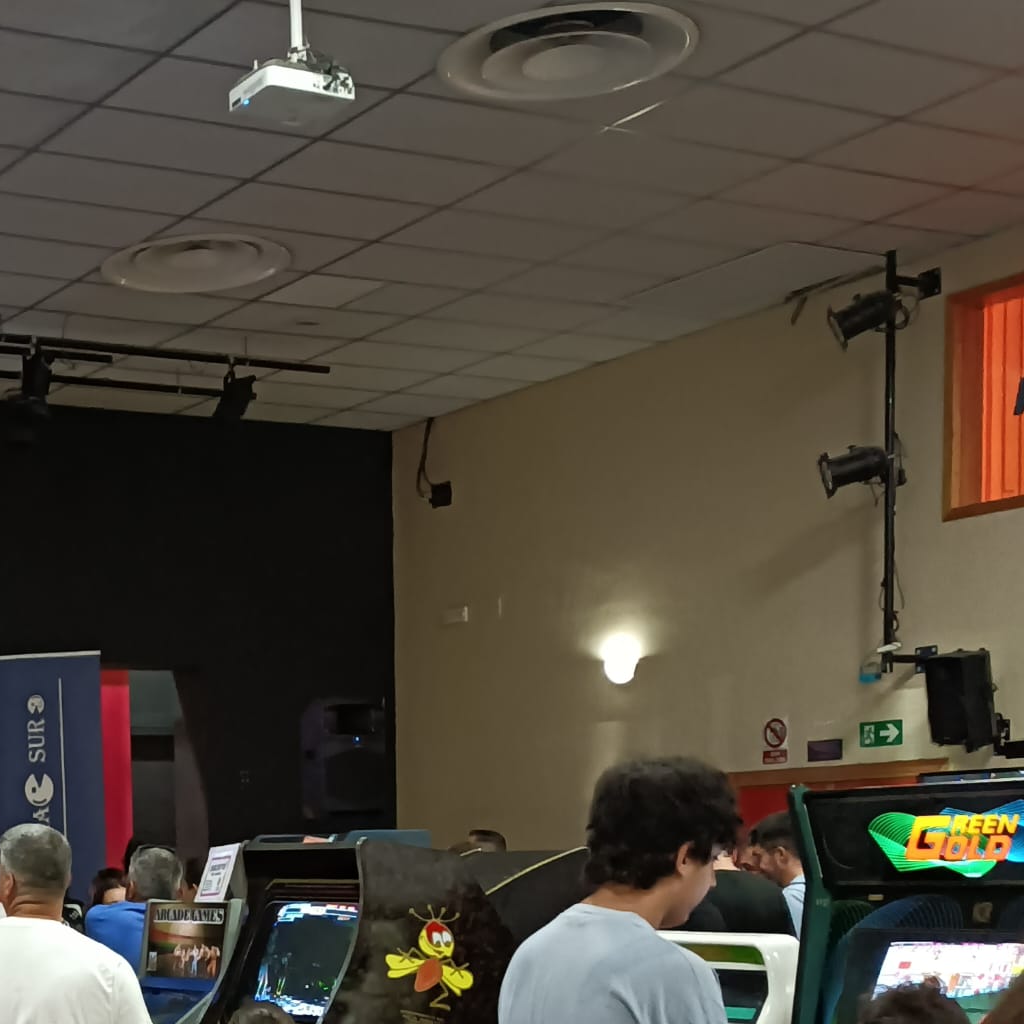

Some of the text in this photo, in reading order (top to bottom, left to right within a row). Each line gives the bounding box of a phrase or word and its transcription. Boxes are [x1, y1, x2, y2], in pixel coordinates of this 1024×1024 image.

[26, 718, 47, 763] SUR
[156, 908, 224, 923] ARCADE GAMES
